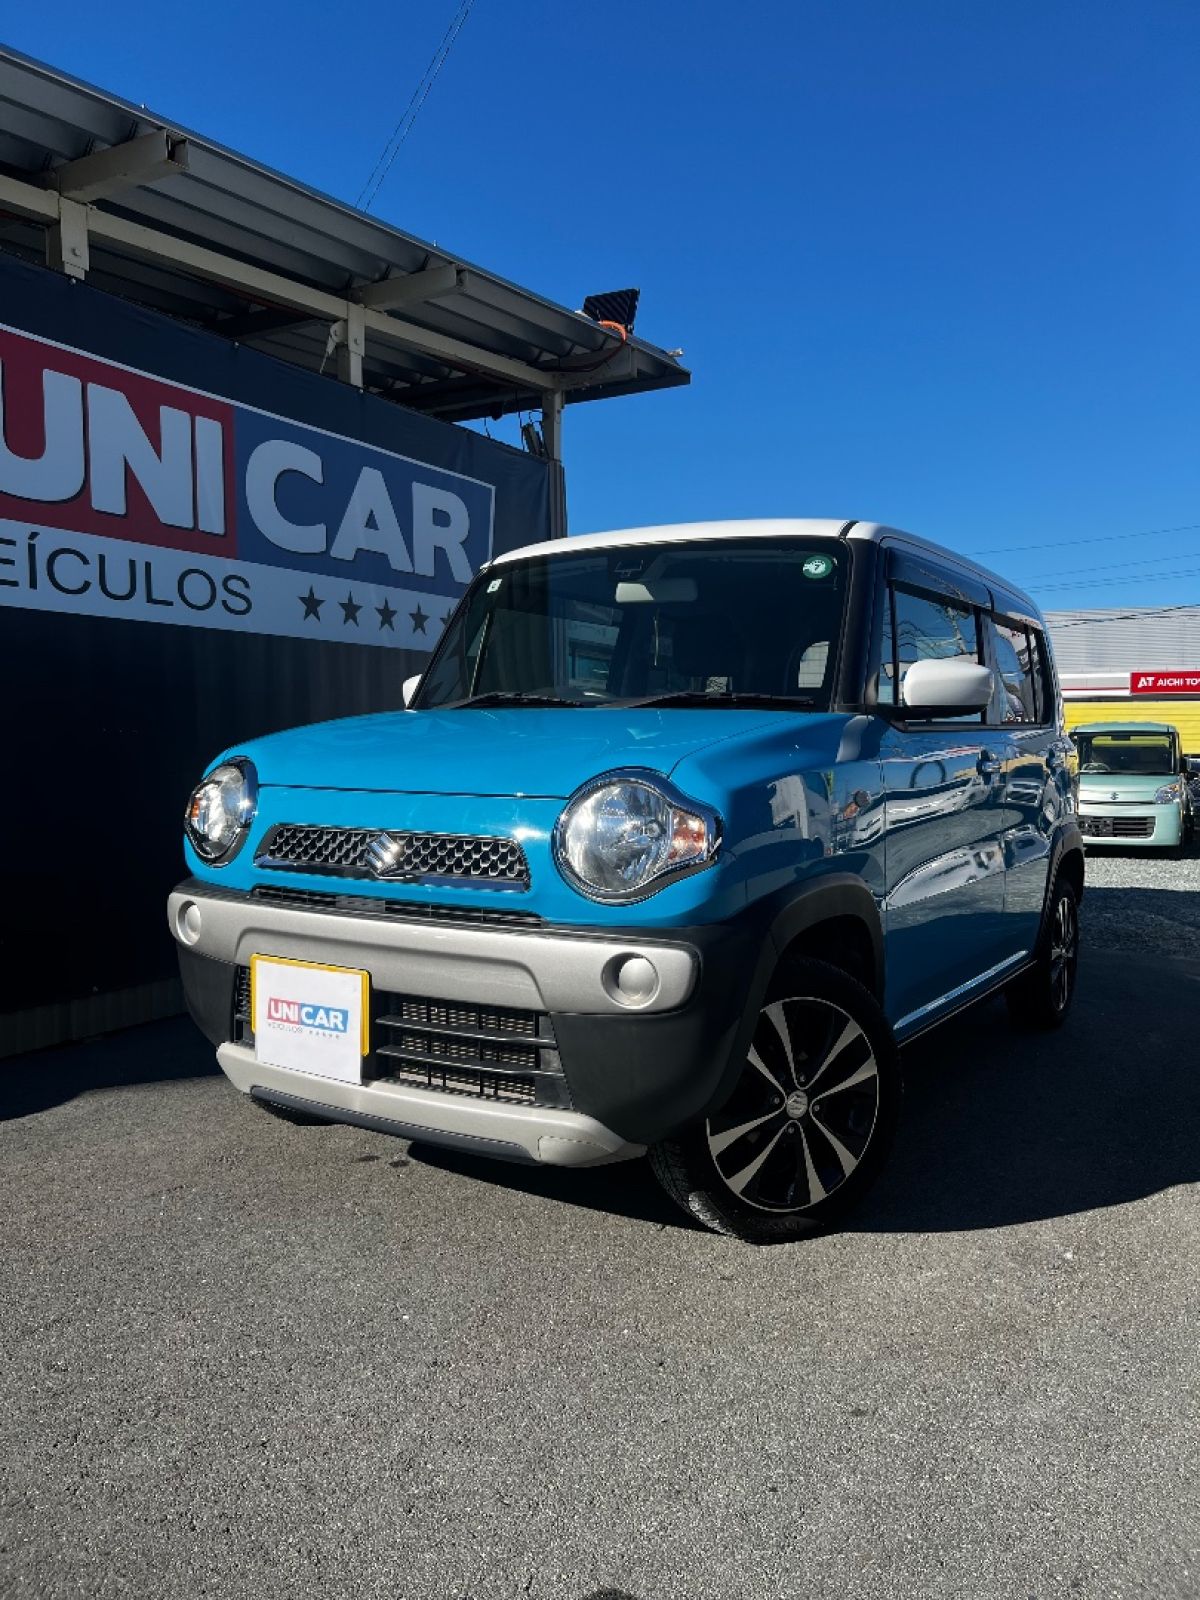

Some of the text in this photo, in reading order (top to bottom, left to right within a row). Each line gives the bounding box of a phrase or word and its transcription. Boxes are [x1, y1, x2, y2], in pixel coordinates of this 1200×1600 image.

[1137, 676, 1200, 688] AT AICHI TO
[270, 1000, 344, 1031] UNICAR
